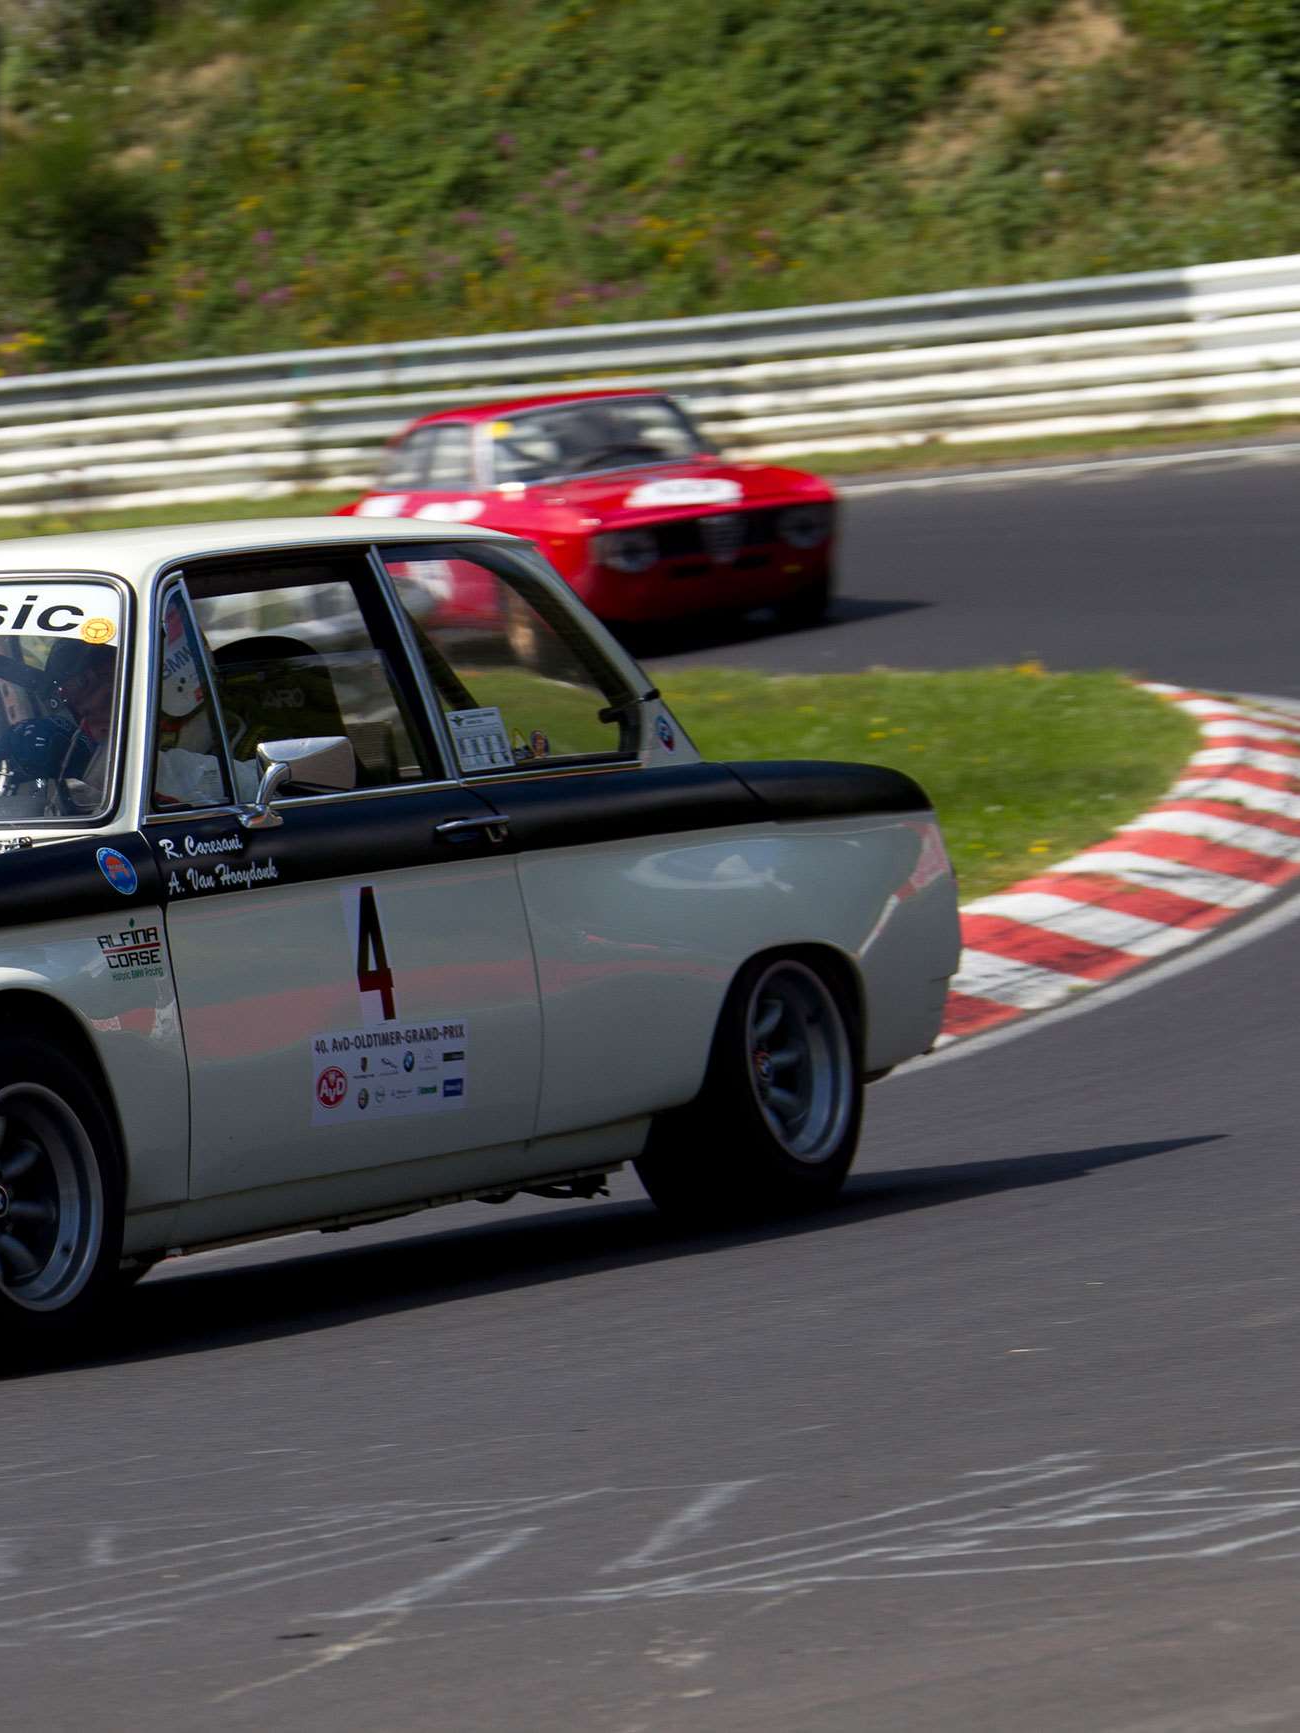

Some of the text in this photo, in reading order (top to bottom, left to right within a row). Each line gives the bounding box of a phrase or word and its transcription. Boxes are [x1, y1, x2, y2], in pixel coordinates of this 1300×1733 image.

[159, 834, 243, 860] R. Caresani
[168, 857, 278, 896] A. Van Hooydonk
[97, 927, 158, 949] ALFINA
[105, 949, 161, 968] CORSE
[357, 886, 396, 1020] 4
[314, 1023, 466, 1055] 40. AvD-OLDTIMER-GRAND-PRIX
[319, 1078, 347, 1102] AvD
